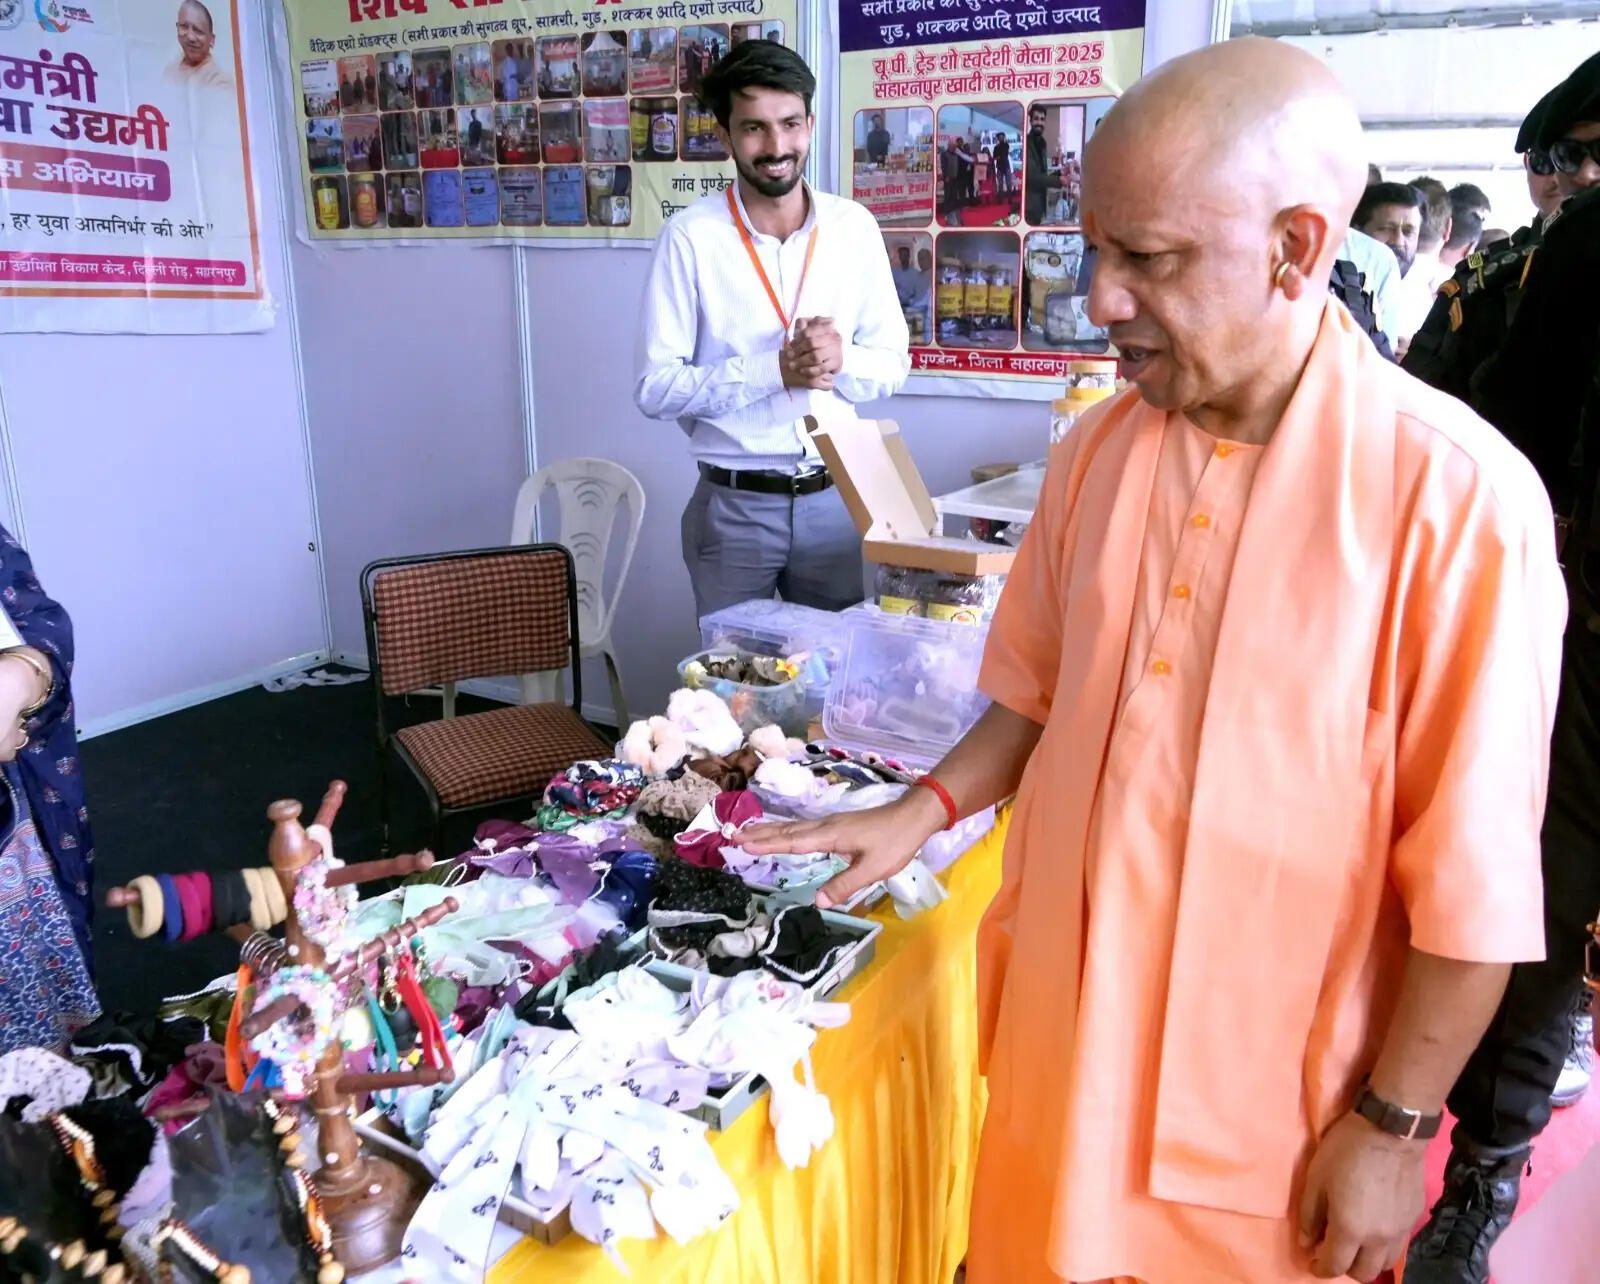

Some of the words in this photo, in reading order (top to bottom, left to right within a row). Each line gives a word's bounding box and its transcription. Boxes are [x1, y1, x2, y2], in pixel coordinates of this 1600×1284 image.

[431, 26, 458, 40] प्रकार
[459, 20, 474, 36] की
[611, 7, 653, 22] शक्कर
[656, 5, 687, 19] आदि
[917, 18, 969, 35] शक्कर
[972, 10, 1012, 30] आदि
[1015, 6, 1048, 30] एग्रो
[1052, 7, 1101, 24] उत्पाद
[915, 50, 937, 76] ट्रेड
[940, 48, 960, 71] शो
[962, 43, 1011, 70] स्वदेशी
[1016, 42, 1052, 66] मेला
[1057, 43, 1103, 63] 2025
[0, 49, 98, 103] मंत्री
[874, 79, 942, 101] सहारनपुर
[946, 71, 983, 94] खादी
[987, 68, 1051, 92] महोत्सव
[1055, 68, 1101, 88] 2025
[46, 104, 169, 151] उद्यमी
[32, 157, 156, 191] अभियान
[672, 173, 695, 193] गांव
[10, 213, 31, 231] हर
[36, 214, 69, 236] युवा
[75, 214, 146, 236] आत्मनिर्भर
[151, 218, 173, 237] की
[9, 257, 57, 273] उद्यमिता
[60, 258, 99, 273] विकास
[968, 351, 1003, 369] जिला
[1010, 357, 1070, 378] सहारनपु
